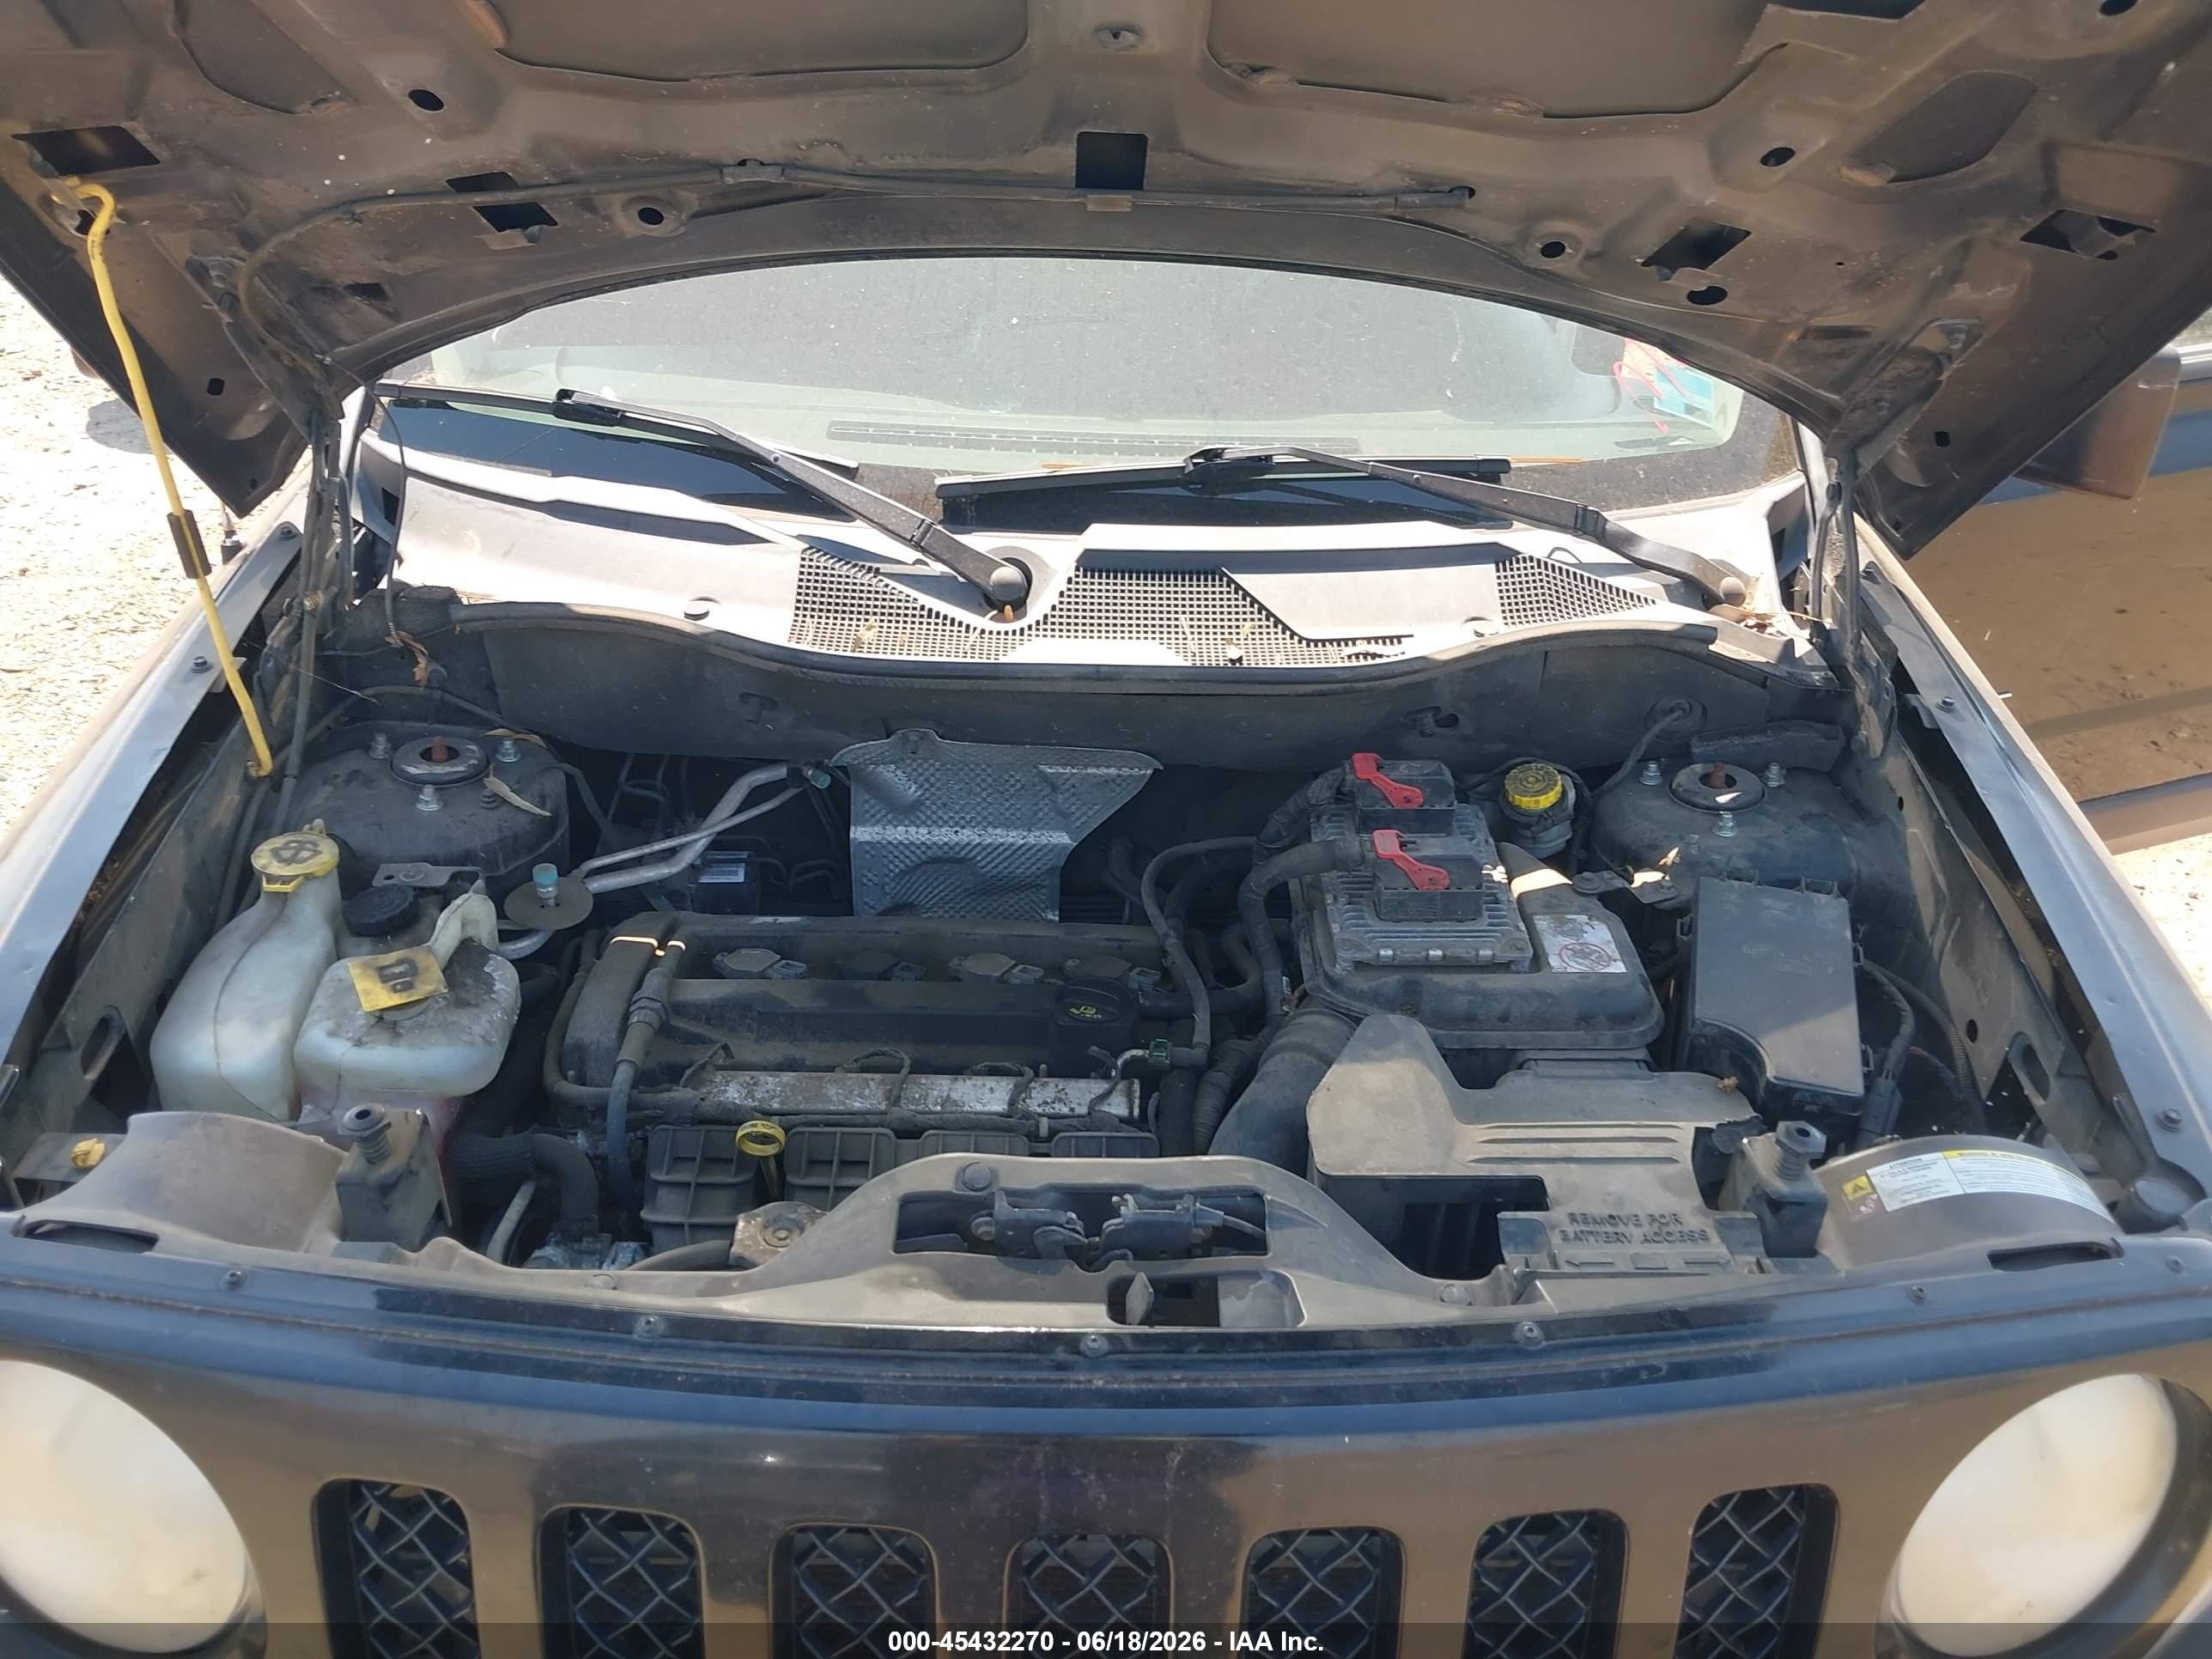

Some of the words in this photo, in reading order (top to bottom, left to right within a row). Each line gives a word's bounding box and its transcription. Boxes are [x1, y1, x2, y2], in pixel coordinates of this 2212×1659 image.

[1566, 1212, 1643, 1228] REMOVE
[1646, 1212, 1683, 1226] FOR
[1559, 1229, 1632, 1244] BATTERY
[1641, 1229, 1711, 1244] ACCESS
